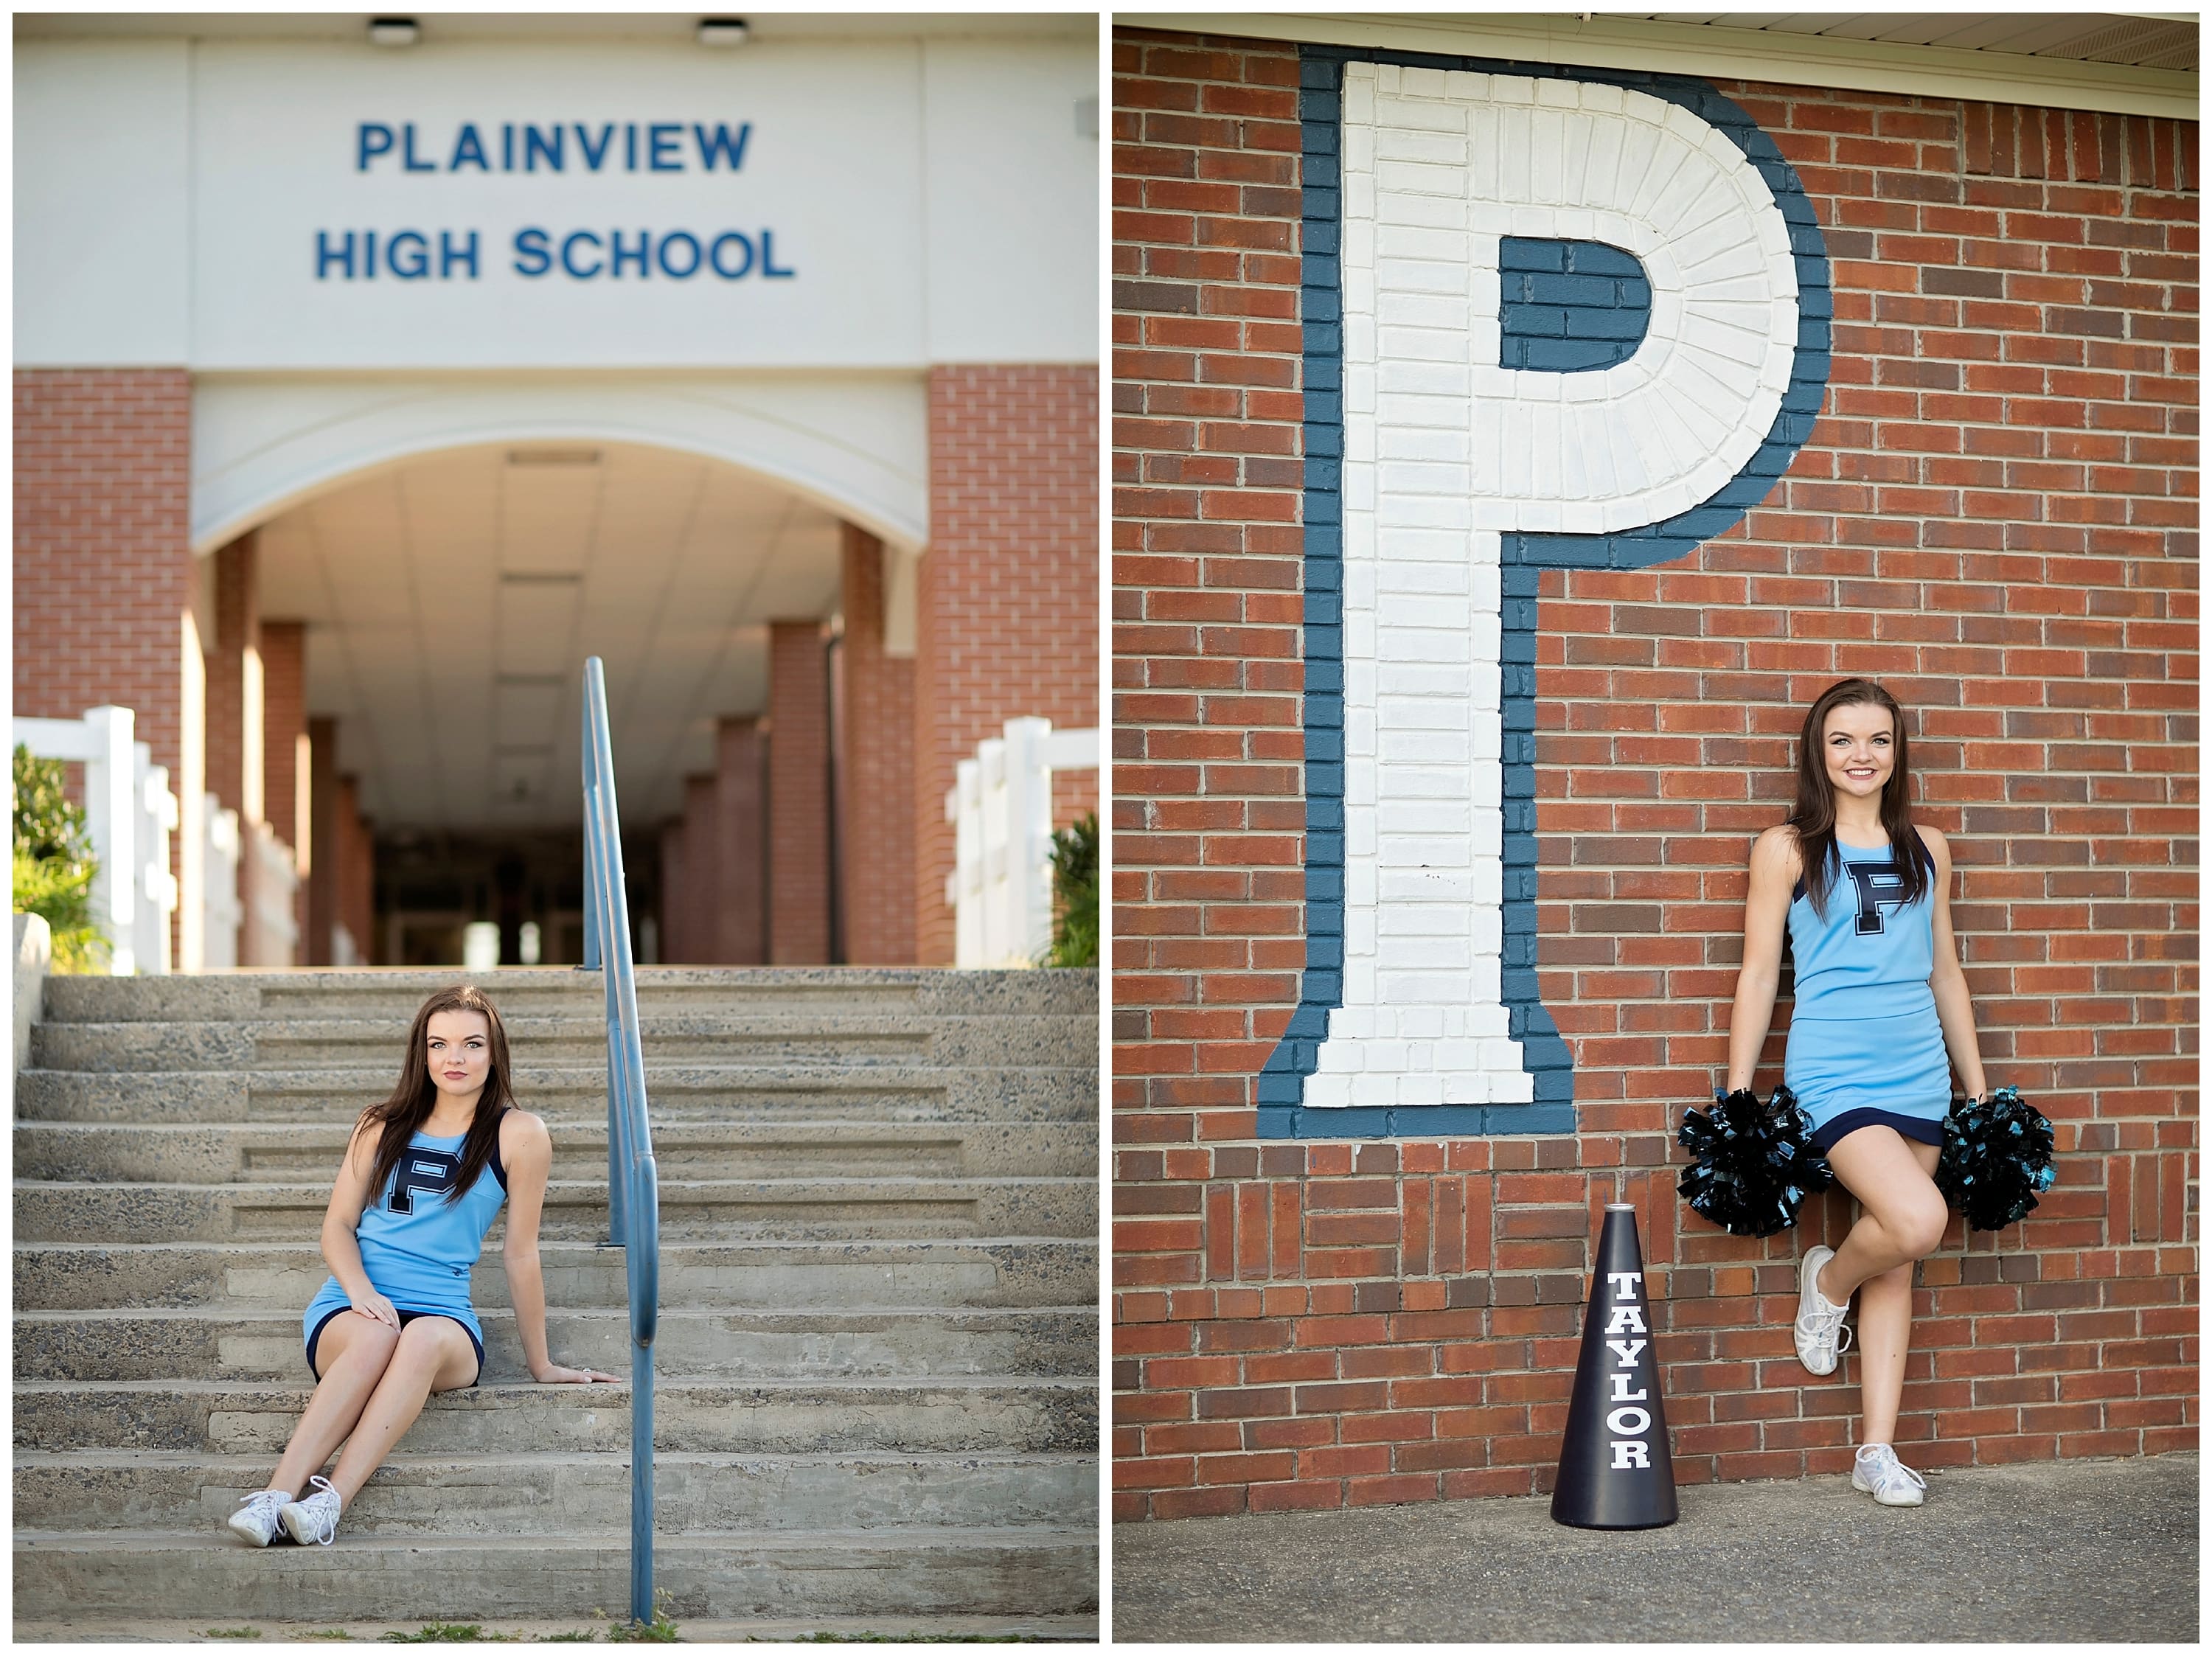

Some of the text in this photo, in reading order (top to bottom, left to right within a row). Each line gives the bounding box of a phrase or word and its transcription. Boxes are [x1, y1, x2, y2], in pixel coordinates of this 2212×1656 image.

[356, 122, 753, 173] PLAINVIEW
[315, 227, 796, 280] HIGH SCHOOL
[1302, 60, 1799, 1107] P
[1843, 860, 1919, 936] P
[387, 1146, 465, 1216] P
[1604, 1272, 1652, 1469] TAYLOR
